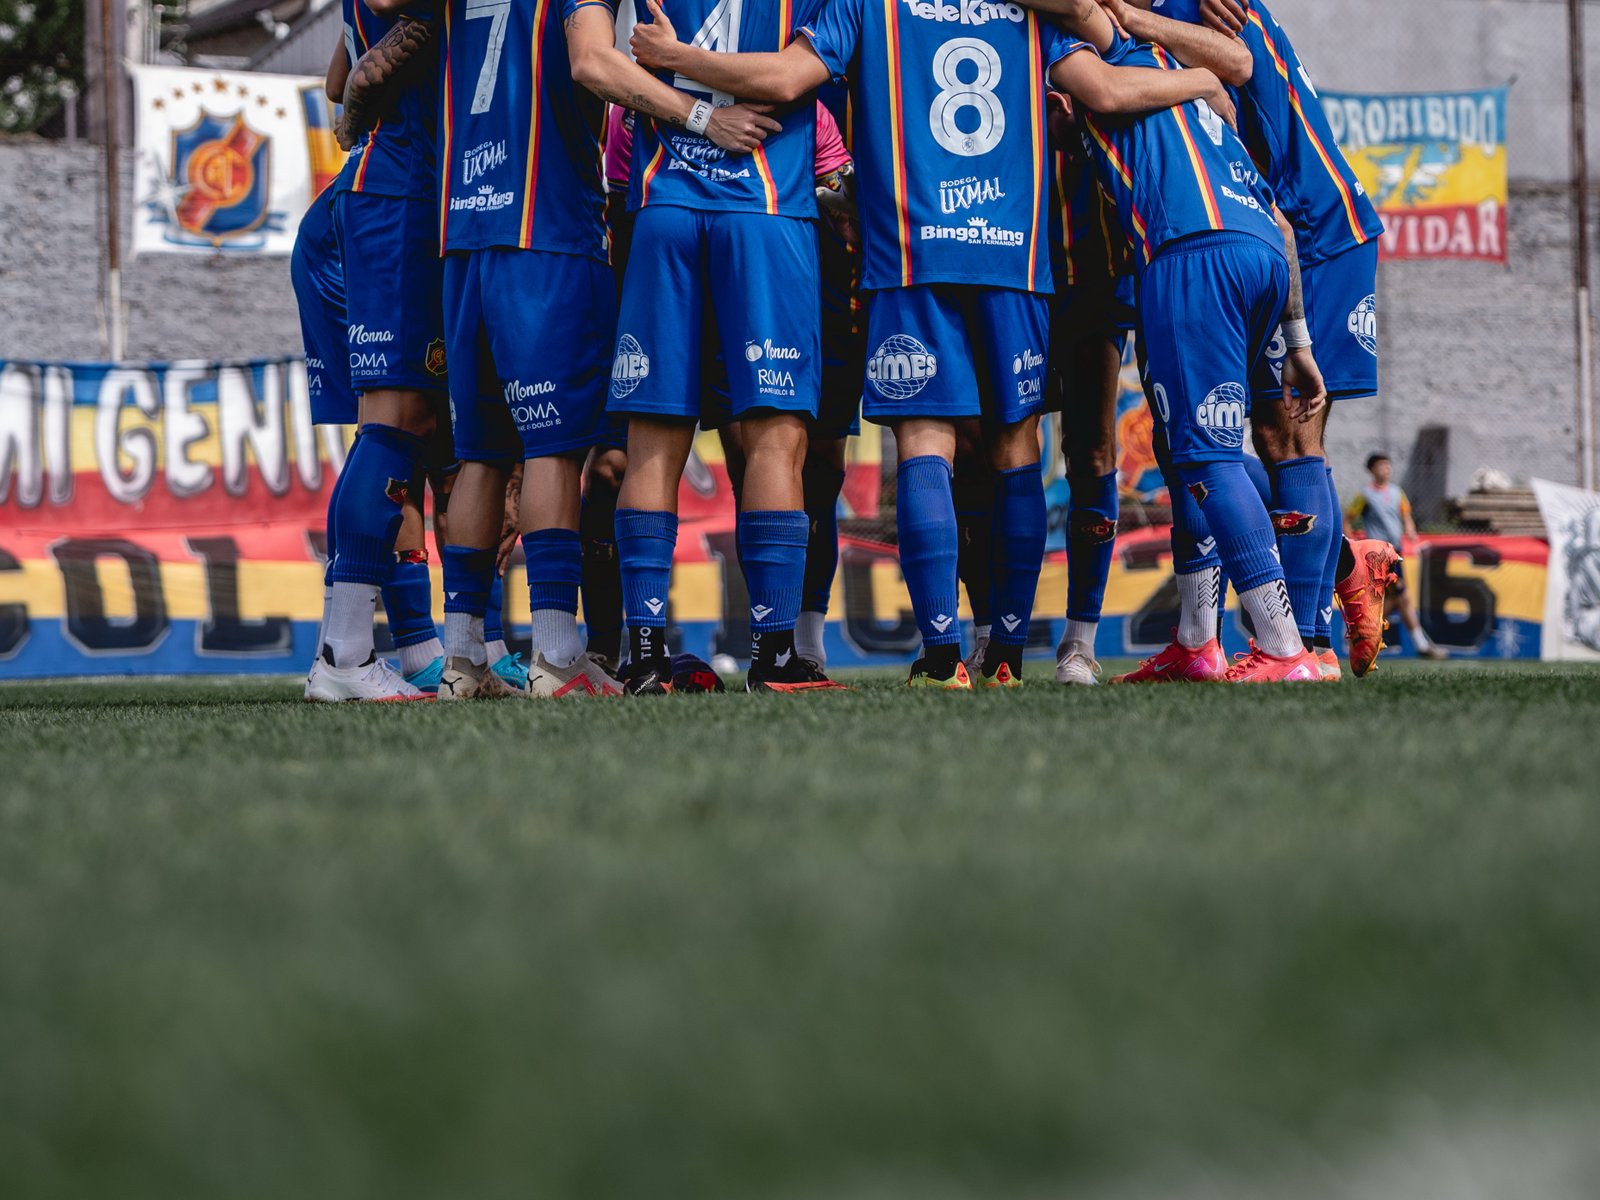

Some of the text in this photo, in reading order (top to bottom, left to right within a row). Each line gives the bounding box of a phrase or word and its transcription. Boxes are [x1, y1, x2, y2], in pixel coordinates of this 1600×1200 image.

[929, 37, 1005, 157] 8
[671, 135, 710, 145] BODEGA
[462, 139, 508, 185] UXMAL
[940, 176, 977, 188] BODEGA
[487, 191, 514, 206] King
[939, 177, 1005, 214] UXMAL
[1220, 185, 1267, 214] Bing
[921, 224, 1024, 246] Bingo King
[1380, 197, 1501, 255] VIDAR
[982, 239, 1016, 247] FERNANDO
[347, 324, 394, 345] Nonna
[349, 352, 388, 368] OMA
[758, 368, 794, 387] ROMA
[1017, 377, 1040, 398] ROMA
[504, 379, 556, 404] Nonna
[511, 401, 560, 423] ROMA
[531, 420, 553, 430] DOLCI
[639, 626, 652, 660] TIFO
